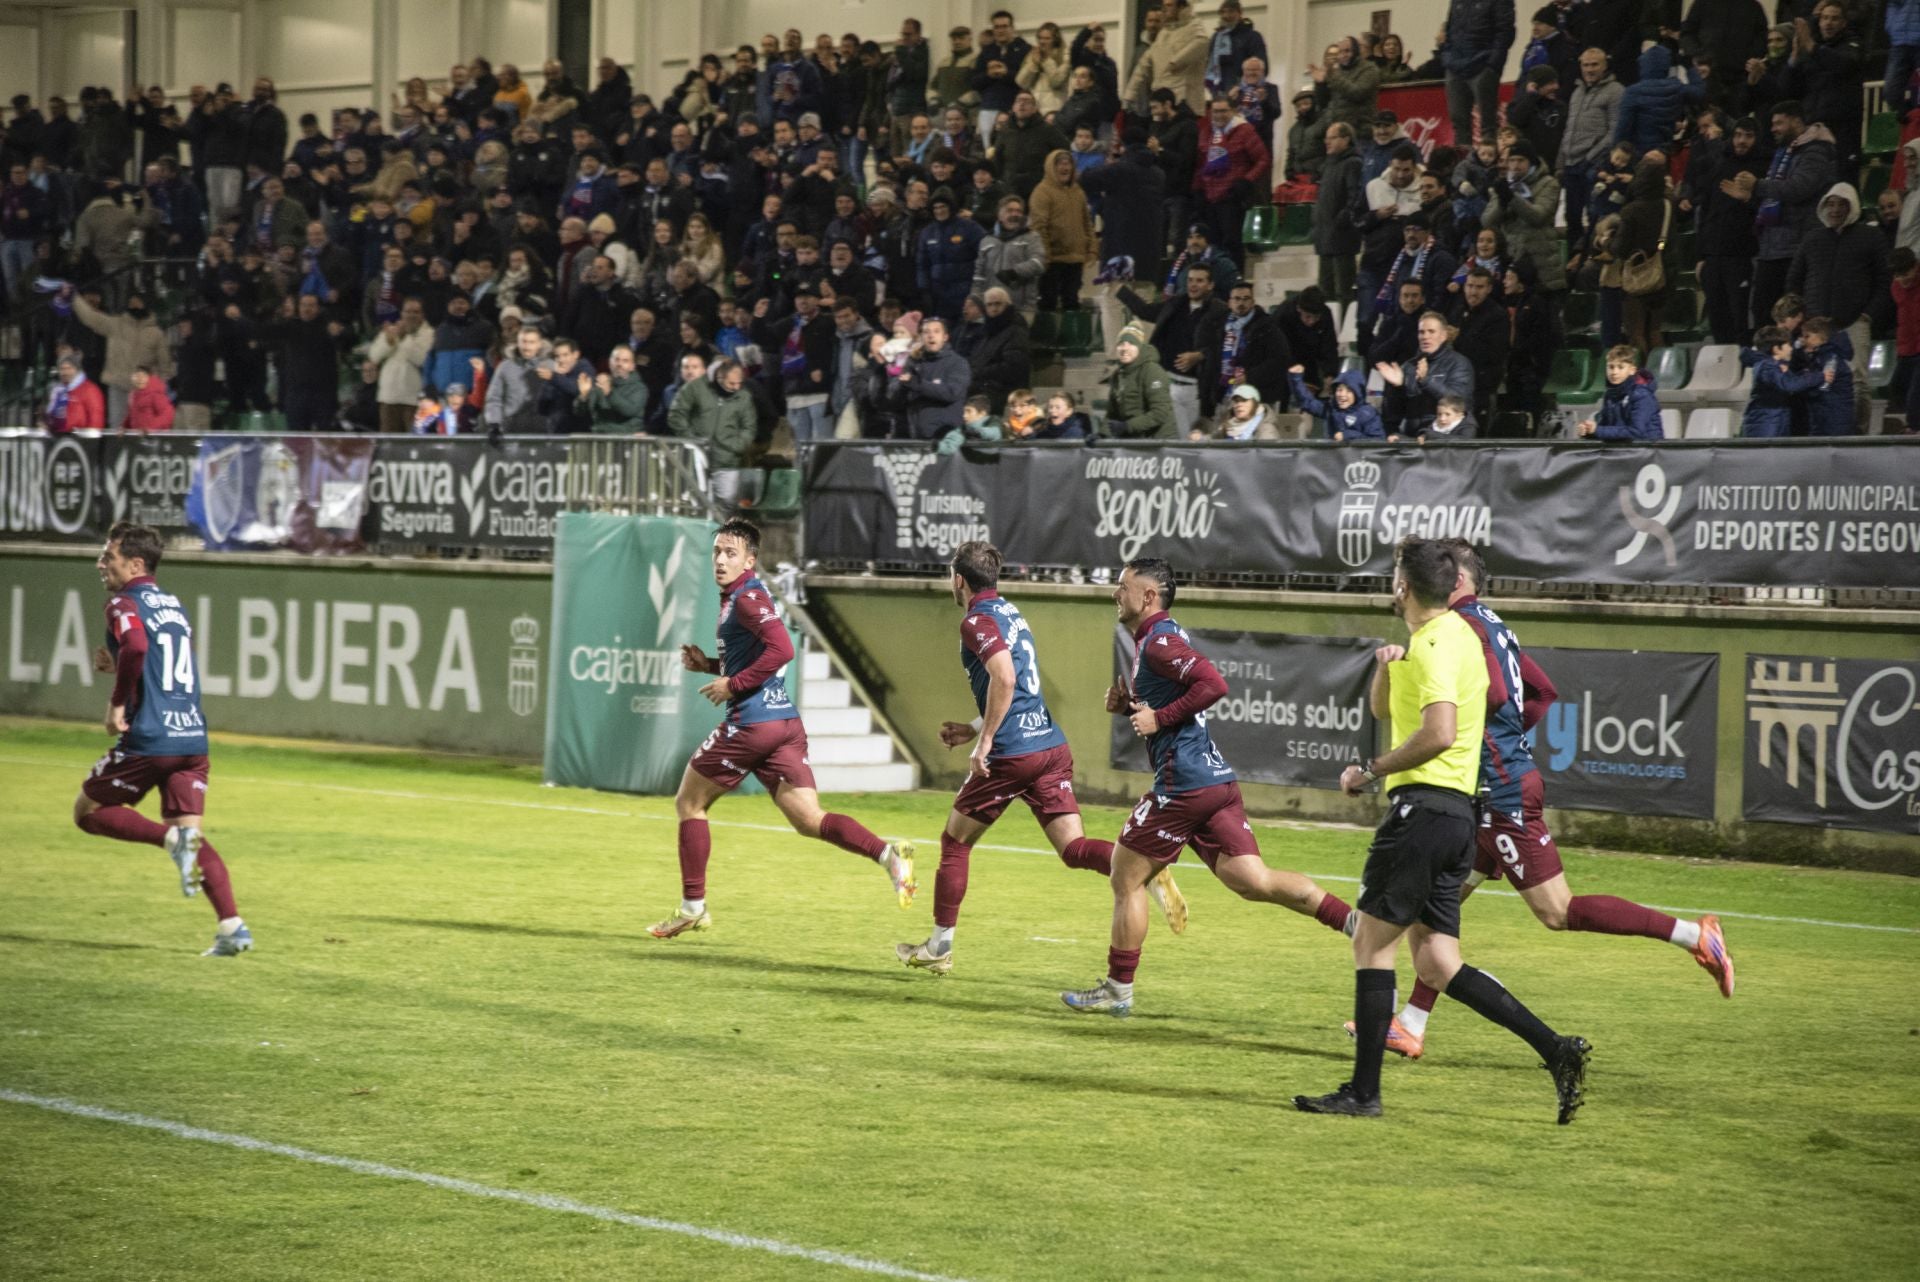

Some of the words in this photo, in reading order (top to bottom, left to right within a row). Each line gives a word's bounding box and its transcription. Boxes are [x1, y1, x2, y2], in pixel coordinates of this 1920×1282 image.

[1085, 457, 1159, 479] amanece
[1161, 457, 1185, 479] en
[919, 489, 972, 514] Turismo
[973, 498, 985, 514] de
[1698, 485, 1800, 511] INSTITUTO
[1807, 485, 1919, 511] MUNICIPAL
[381, 505, 454, 538] Segovia
[916, 515, 990, 556] Segovia
[1378, 505, 1491, 546] SEGOVIA
[1694, 521, 1820, 552] DEPORTES
[9, 585, 93, 687] LA
[197, 595, 482, 713] LBUERA
[157, 633, 194, 694] 14
[1022, 639, 1040, 695] 3
[1303, 695, 1364, 731] salud
[1527, 690, 1685, 772] ylock
[1286, 740, 1361, 763] SEGOVIA
[1583, 760, 1687, 780] TECHNOLOGIES
[1134, 800, 1152, 826] 4
[1496, 834, 1519, 864] 9
